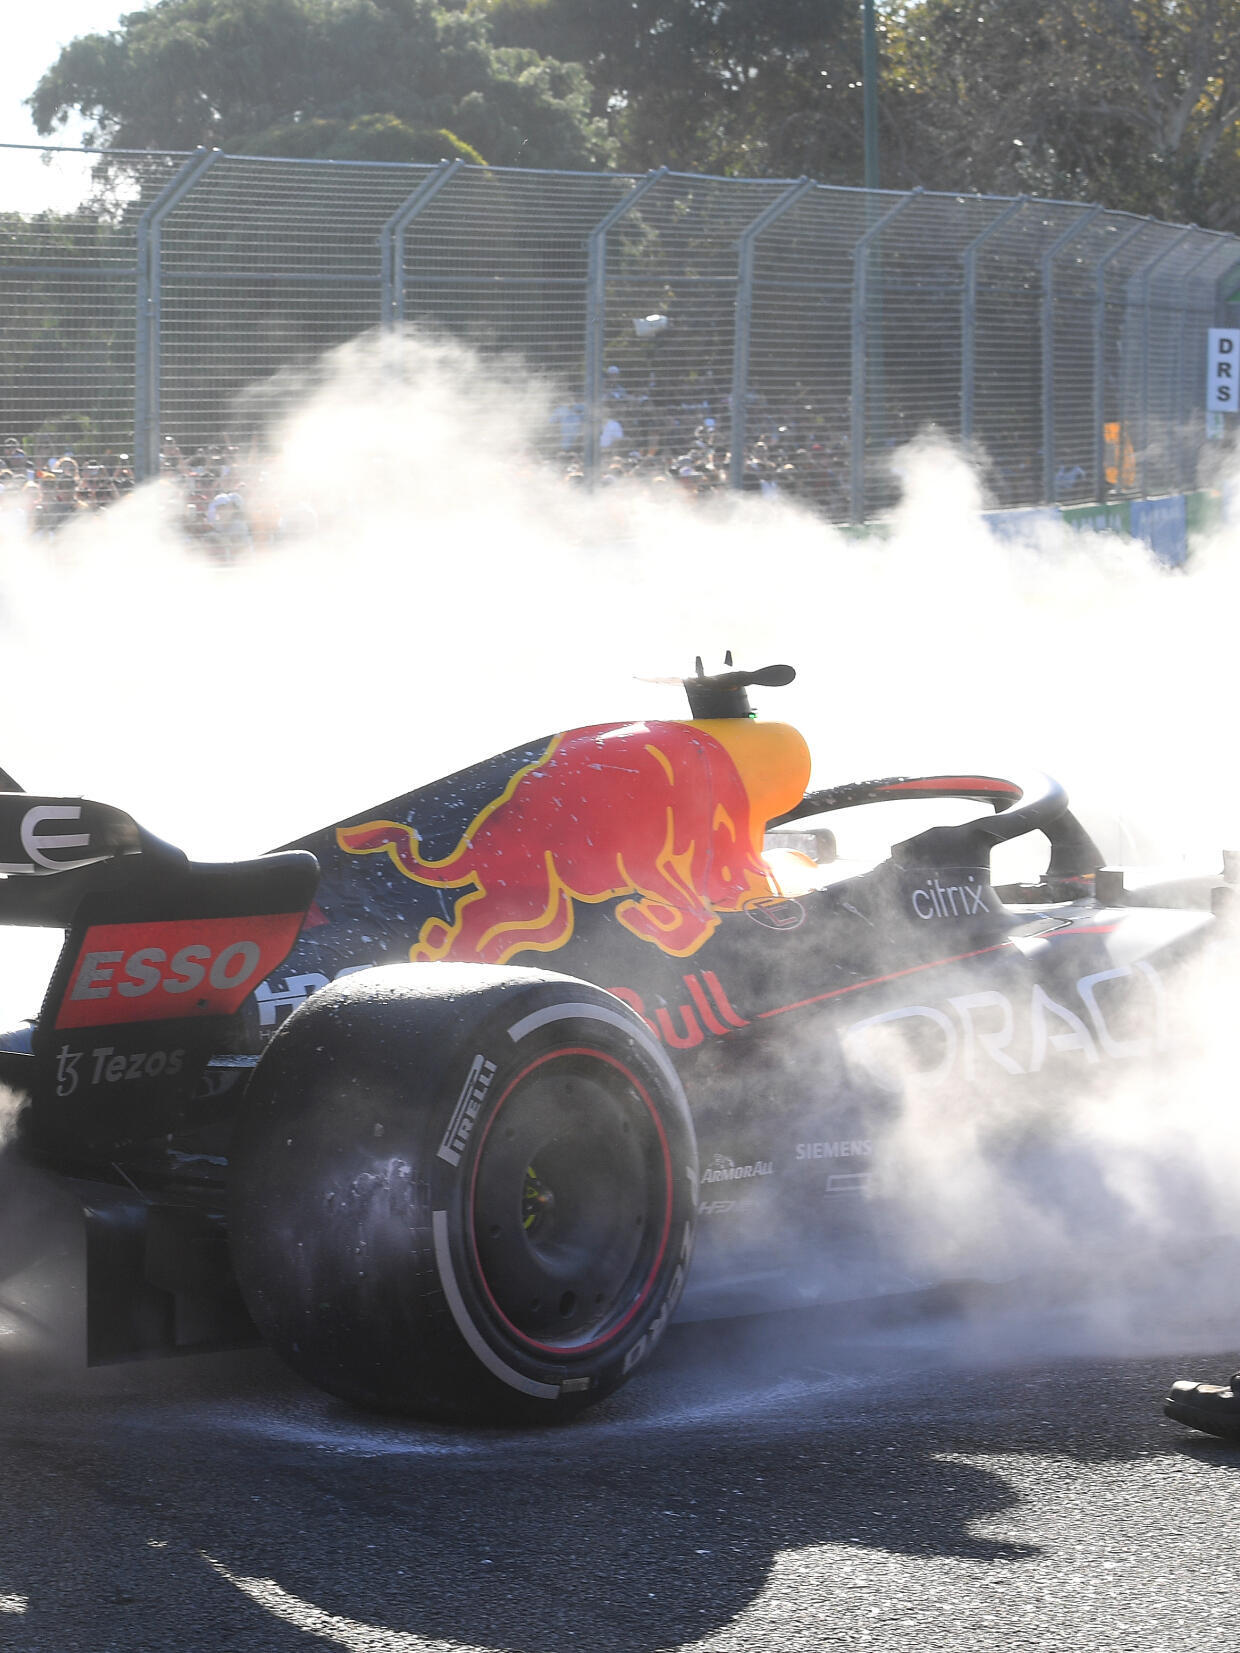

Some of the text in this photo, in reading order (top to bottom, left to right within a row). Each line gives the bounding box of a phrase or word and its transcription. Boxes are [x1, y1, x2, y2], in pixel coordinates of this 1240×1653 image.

[1216, 337, 1234, 402] DRS
[912, 875, 990, 920] citrix
[70, 940, 261, 1001] ESSO
[91, 1047, 185, 1085] Tezos
[436, 1053, 498, 1168] PIRELLI
[795, 1139, 872, 1160] SIEMENS
